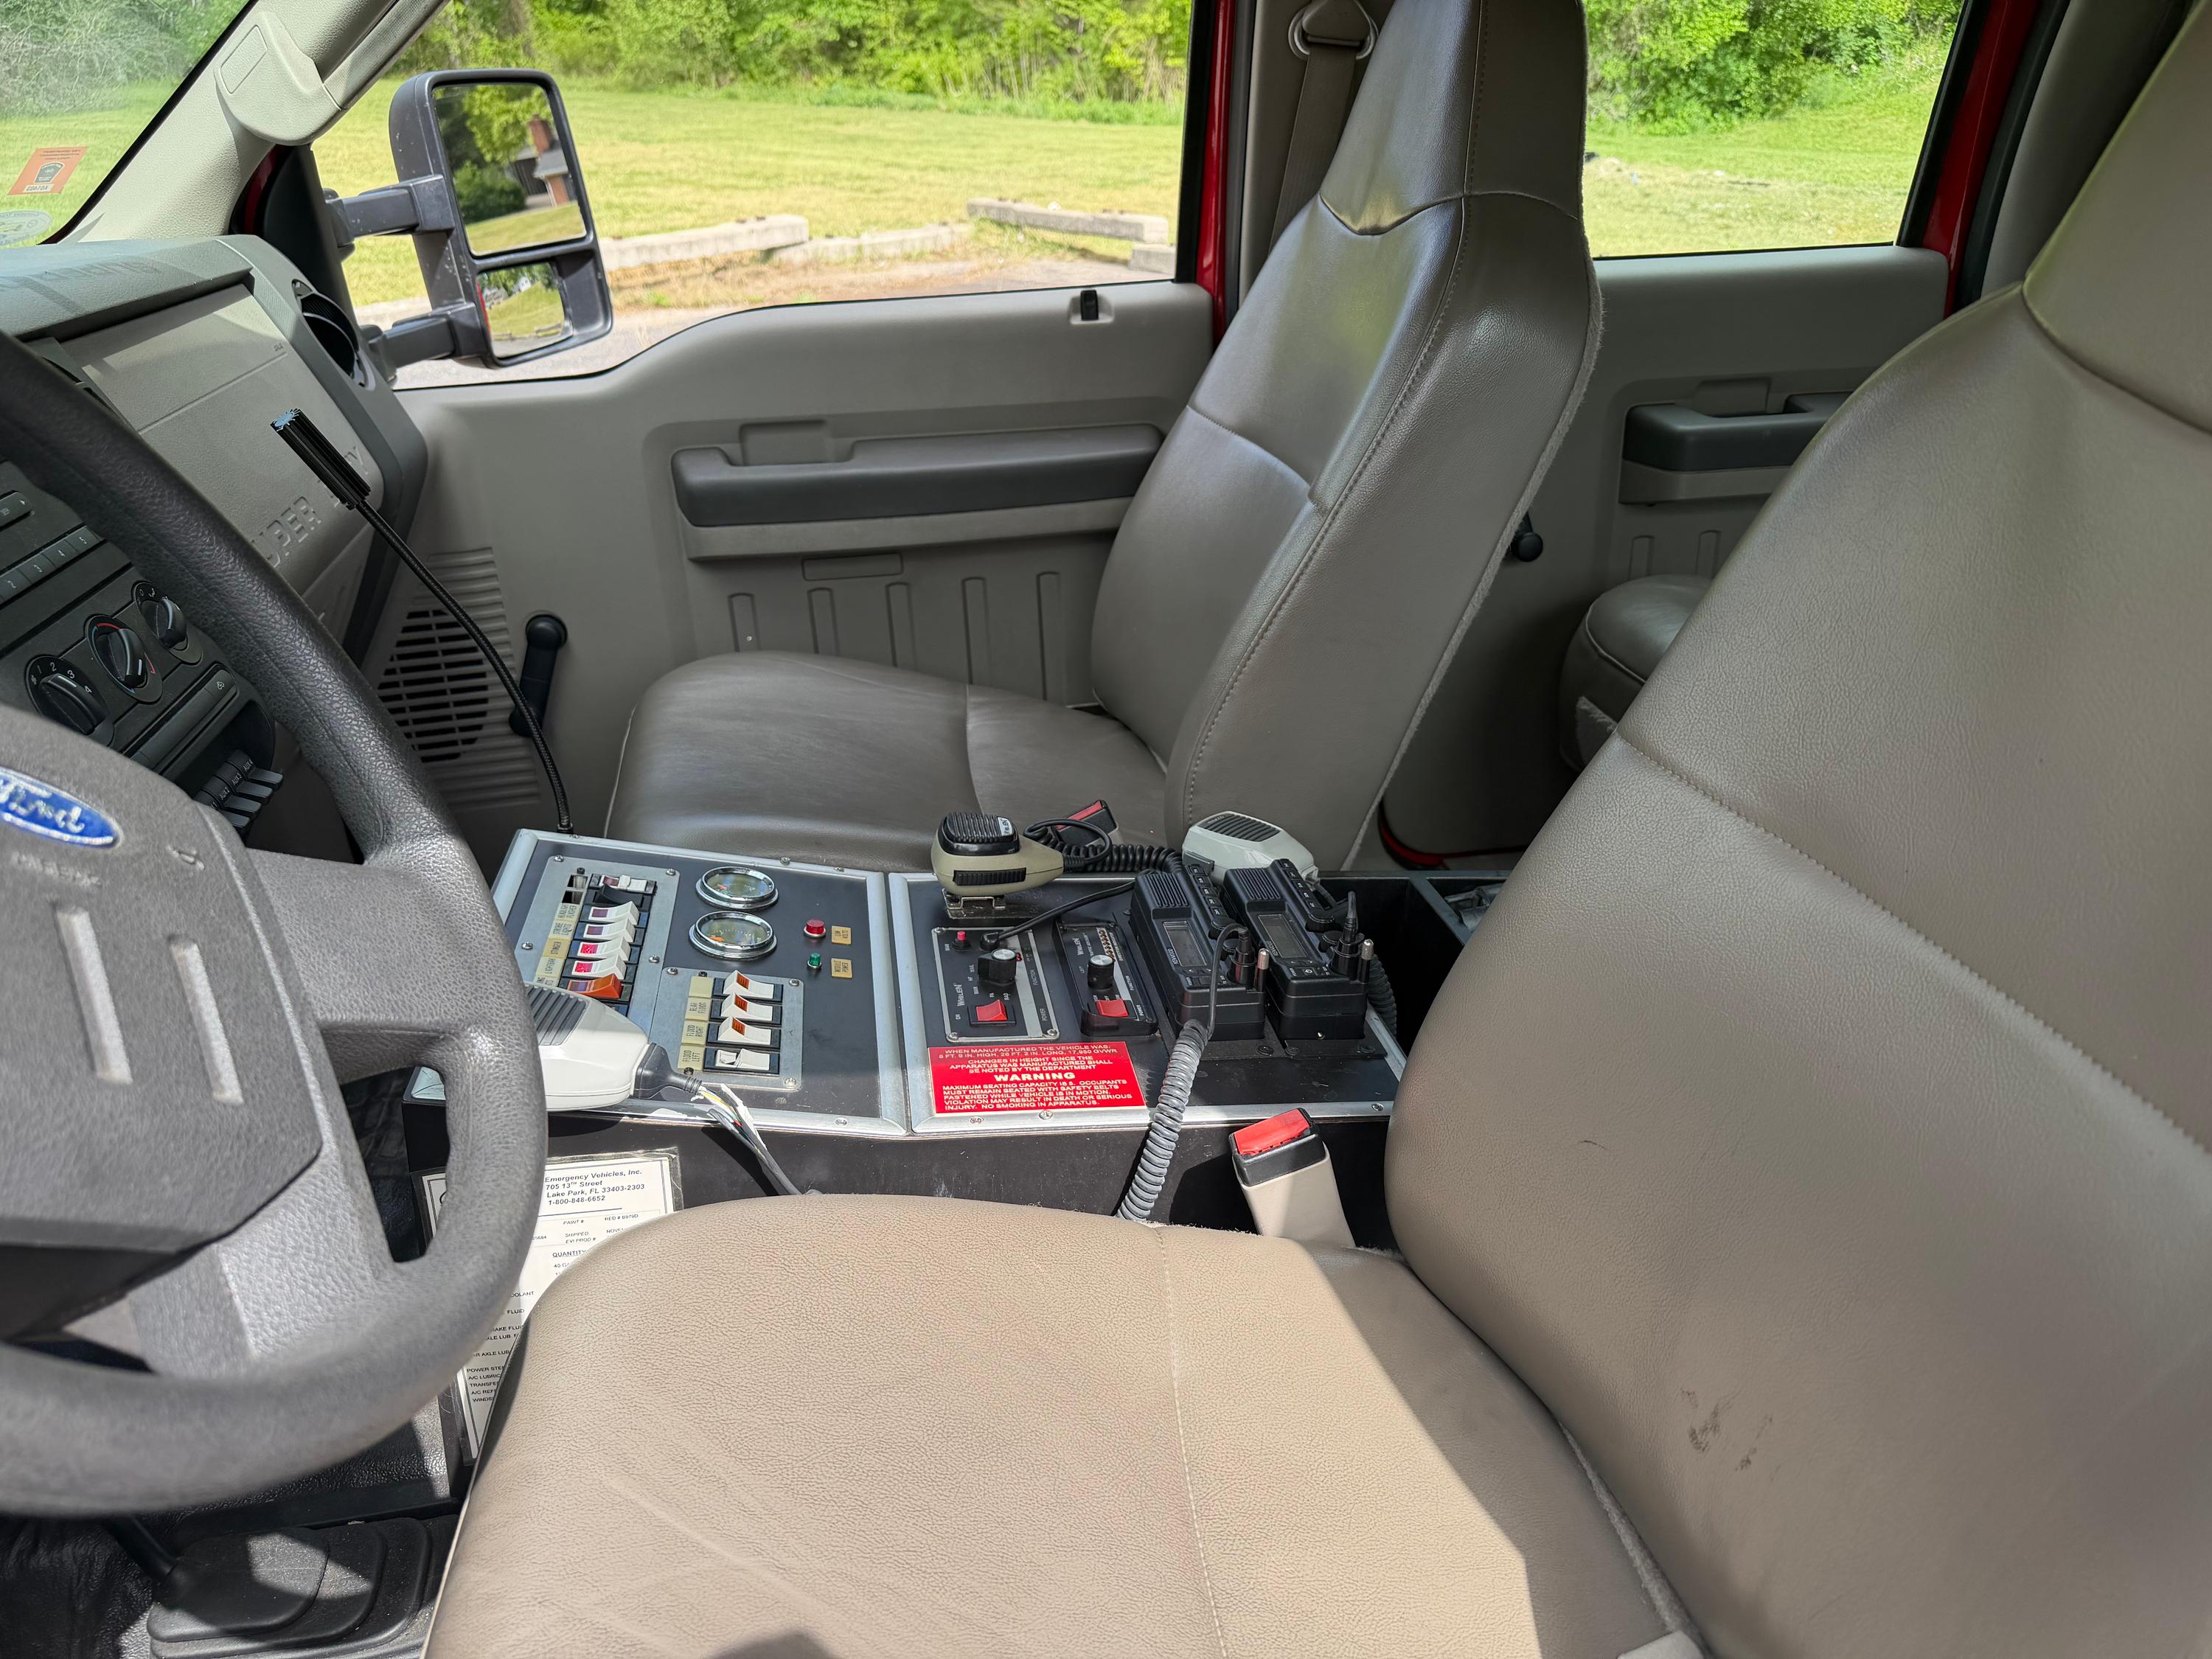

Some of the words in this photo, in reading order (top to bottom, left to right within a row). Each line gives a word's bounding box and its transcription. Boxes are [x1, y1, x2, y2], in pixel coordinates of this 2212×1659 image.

[251, 495, 322, 568] UPER
[49, 661, 58, 672] 2
[67, 669, 75, 679] 3
[84, 685, 92, 694] 4
[686, 1024, 695, 1037] FLOOD
[682, 1049, 692, 1062] FLOOD
[692, 1052, 700, 1062] LEFT
[994, 1071, 1076, 1082] WARNING
[545, 1174, 589, 1183] Emergency
[591, 1171, 626, 1179] Vehicles,
[546, 1190, 566, 1198] Lake
[567, 1189, 588, 1197] Park,
[602, 1183, 645, 1193] 33403-2303
[548, 1195, 605, 1206] 1-800-848-6652
